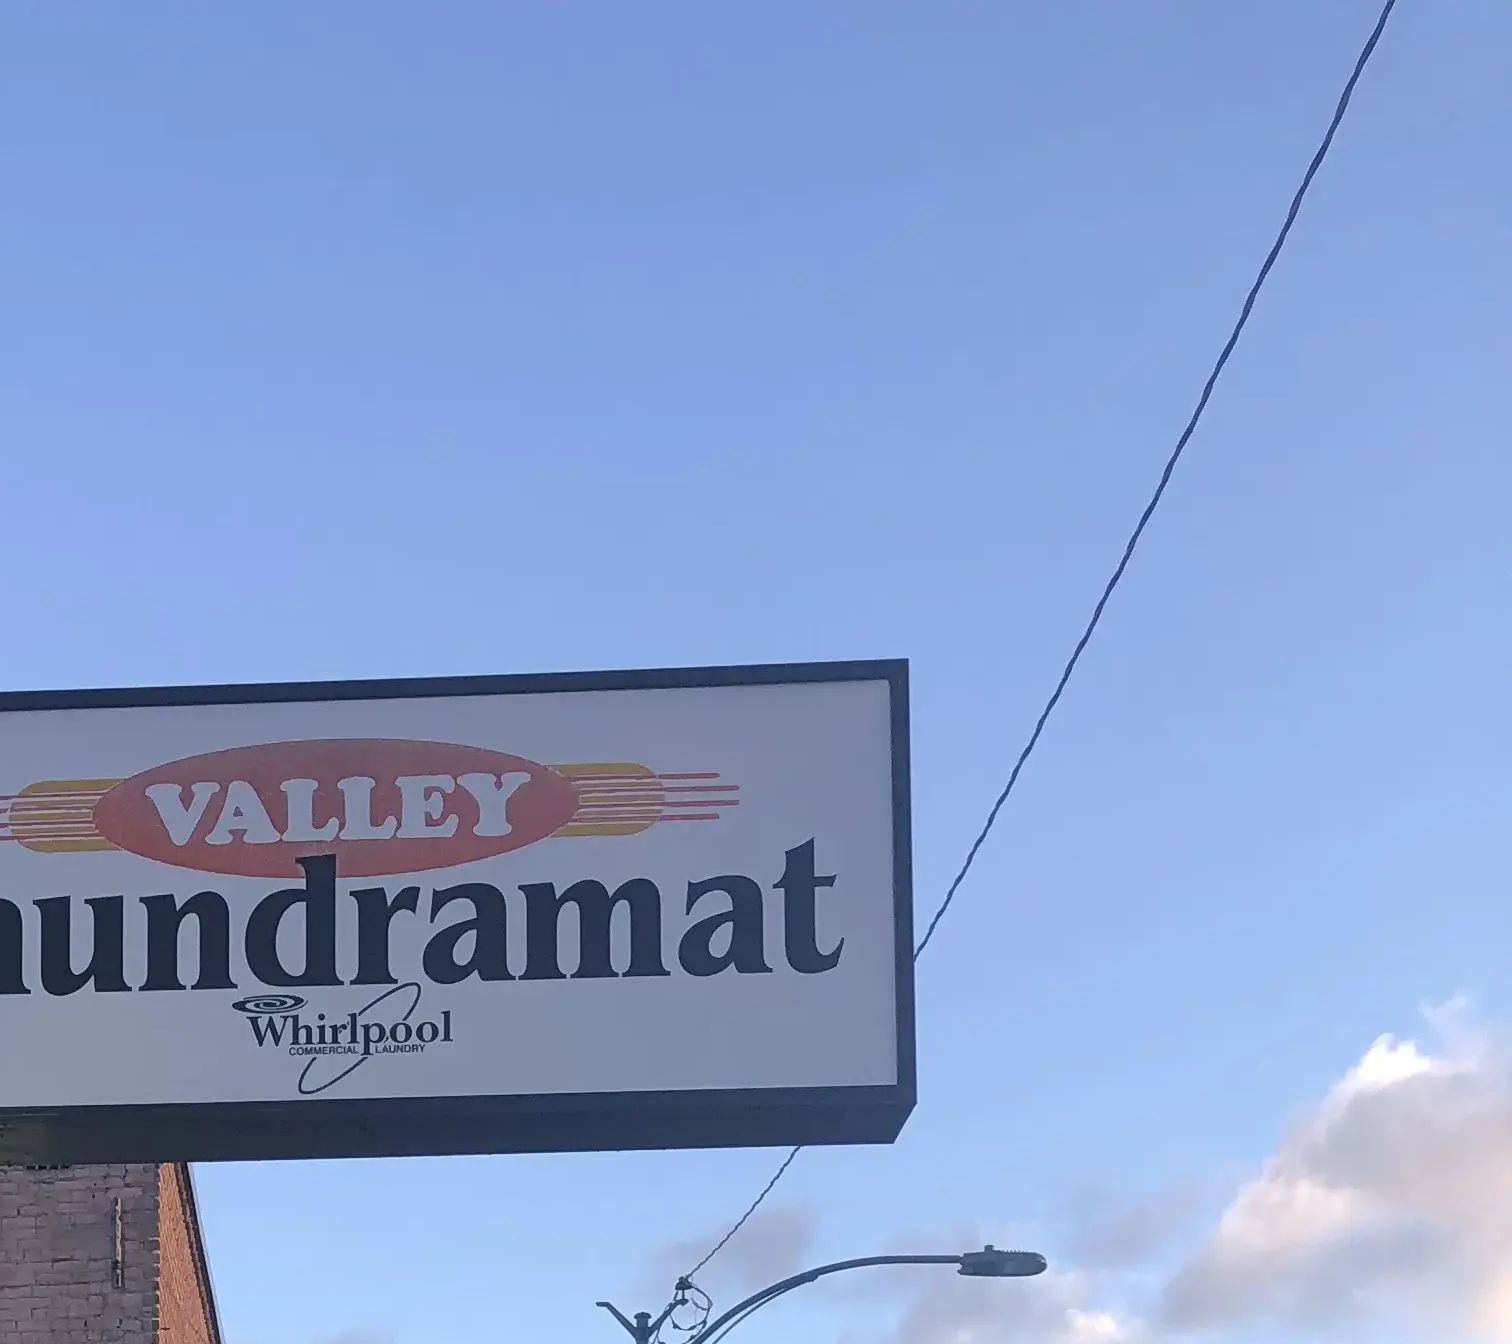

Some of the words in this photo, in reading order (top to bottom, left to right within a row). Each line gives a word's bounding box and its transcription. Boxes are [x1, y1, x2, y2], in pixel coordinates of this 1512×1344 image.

[144, 771, 531, 847] VALLEY
[246, 1010, 453, 1056] Whirlpool
[289, 1045, 359, 1056] COMMERCIAL
[375, 1044, 426, 1054] LAUNDRY
